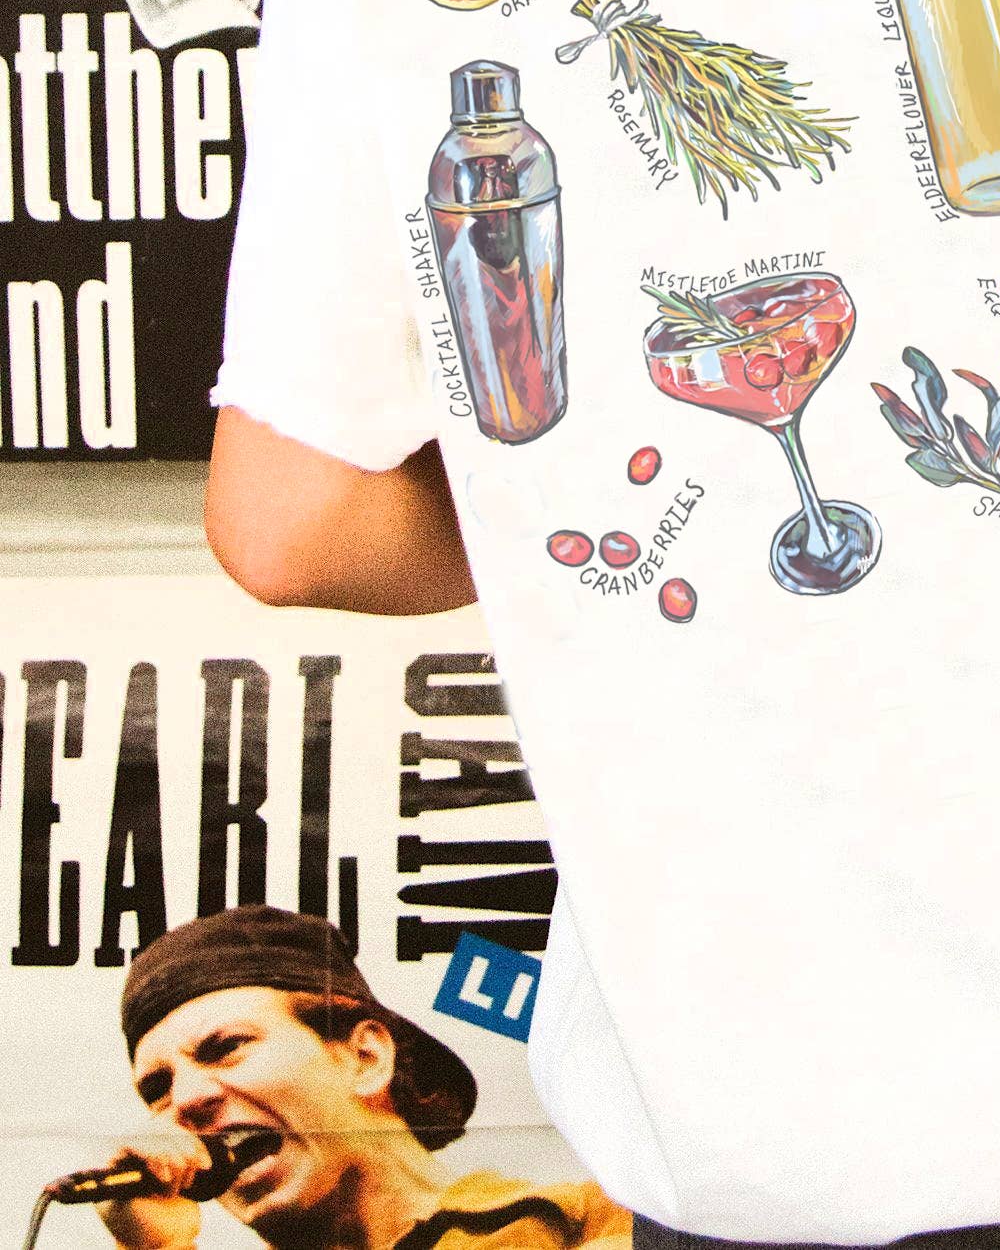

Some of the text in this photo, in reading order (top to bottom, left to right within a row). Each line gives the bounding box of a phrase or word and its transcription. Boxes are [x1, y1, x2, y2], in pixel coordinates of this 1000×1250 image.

[0, 11, 259, 222] tthe
[607, 88, 679, 191] ROSEMARY
[405, 207, 472, 418] COCKTAIL SHAKER
[640, 250, 827, 295] MISTLETOE MARTINI
[579, 478, 705, 597] CRANBERRIES
[0, 655, 358, 967] EARL
